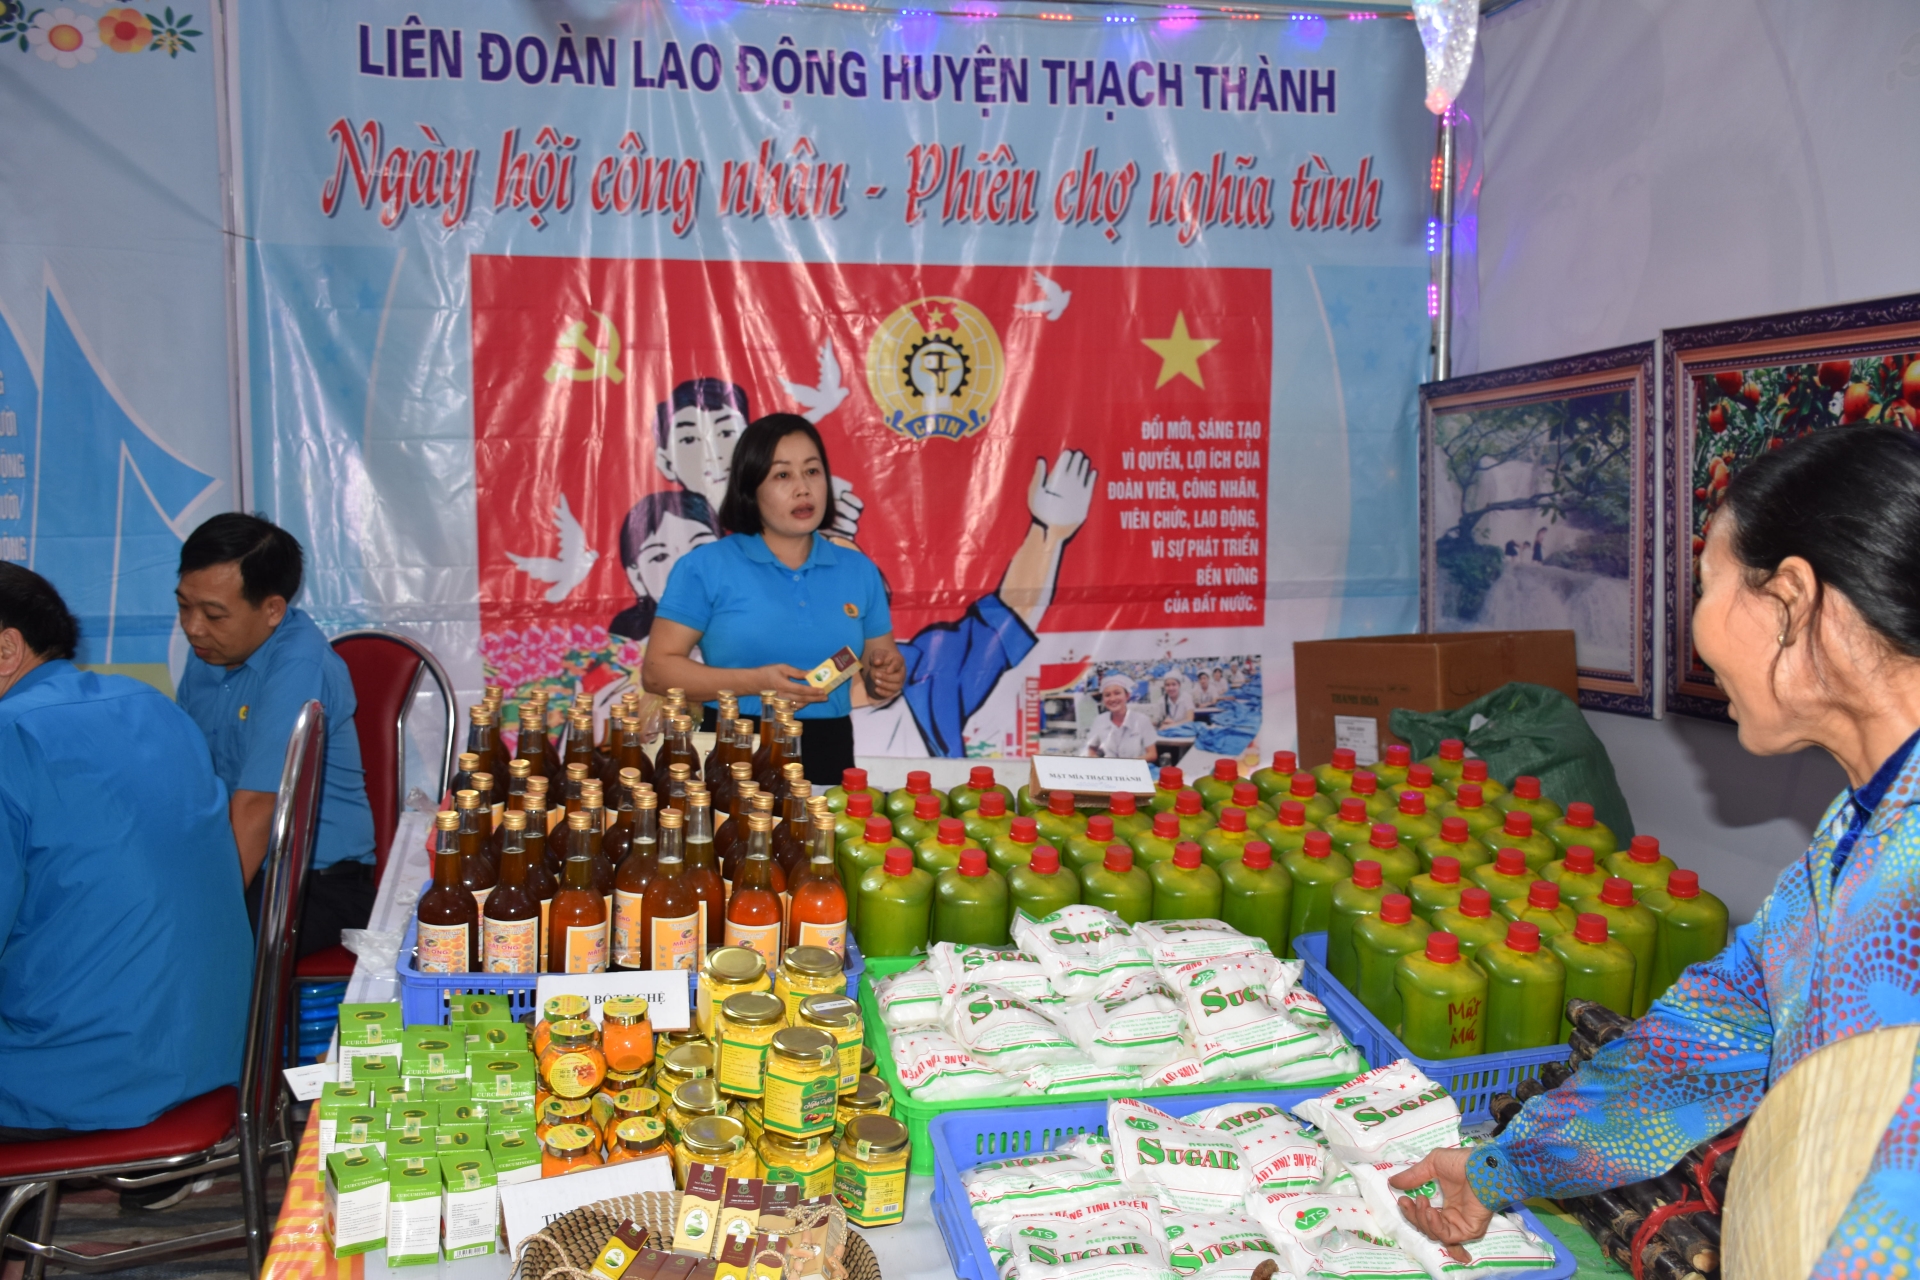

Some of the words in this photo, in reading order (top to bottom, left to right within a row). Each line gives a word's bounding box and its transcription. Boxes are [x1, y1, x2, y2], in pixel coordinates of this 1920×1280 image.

[358, 15, 464, 79] LIÊN
[477, 23, 616, 88] ĐOÀN
[632, 39, 723, 92] LAO
[735, 36, 868, 111] ĐỘNG
[881, 45, 1030, 118] HUYỆN
[1040, 59, 1185, 121] THẠCH
[1195, 55, 1337, 114] THÀNH
[322, 117, 479, 229] Ngày
[494, 126, 580, 232] hội
[589, 130, 704, 239] công
[717, 135, 849, 219] nhân
[905, 142, 1040, 226] Phiên
[1054, 147, 1139, 244] chợ
[1148, 155, 1275, 247] nghĩa
[1289, 154, 1385, 230] tình
[913, 416, 961, 435] CVN
[1141, 414, 1164, 440] ĐỔI
[1167, 415, 1196, 441] MỚI,
[1198, 417, 1234, 440] SÁNG
[1237, 421, 1262, 447] TẠO
[1122, 447, 1135, 470] VÌ
[1187, 449, 1207, 473] LỢI
[1209, 447, 1232, 469] ÍCH
[1235, 445, 1261, 469] CỦA
[1107, 477, 1144, 500] ĐOÀN
[1146, 477, 1180, 501] VIÊN,
[1182, 477, 1217, 499] CÔNG
[1220, 476, 1260, 500] NHÂN,
[1120, 507, 1150, 530] VIÊN
[1153, 505, 1191, 531] CHỨC,
[1193, 510, 1218, 529] LAO
[1220, 505, 1260, 532] ĐỘNG,
[1151, 536, 1165, 559] VÌ
[1167, 537, 1187, 562] SỰ
[1187, 535, 1219, 558] PHÁT
[1222, 531, 1259, 557] TRIỂN
[1224, 562, 1259, 586] VỮNG
[1164, 590, 1190, 614] CỦA
[1192, 590, 1217, 613] ĐẤT
[1219, 591, 1258, 612] NƯỚC.
[1448, 996, 1482, 1026] Mật
[345, 1038, 398, 1046] CURCUOIDS
[1129, 1119, 1156, 1130] VTS
[1136, 1136, 1241, 1171] SUGAR
[396, 1190, 437, 1199] CURCUMINOIDS
[1086, 1202, 1111, 1214] TINH
[1298, 1210, 1327, 1226] VTS
[1025, 1228, 1054, 1240] VTS
[1165, 1226, 1182, 1240] TS
[1028, 1242, 1149, 1266] SUGAR
